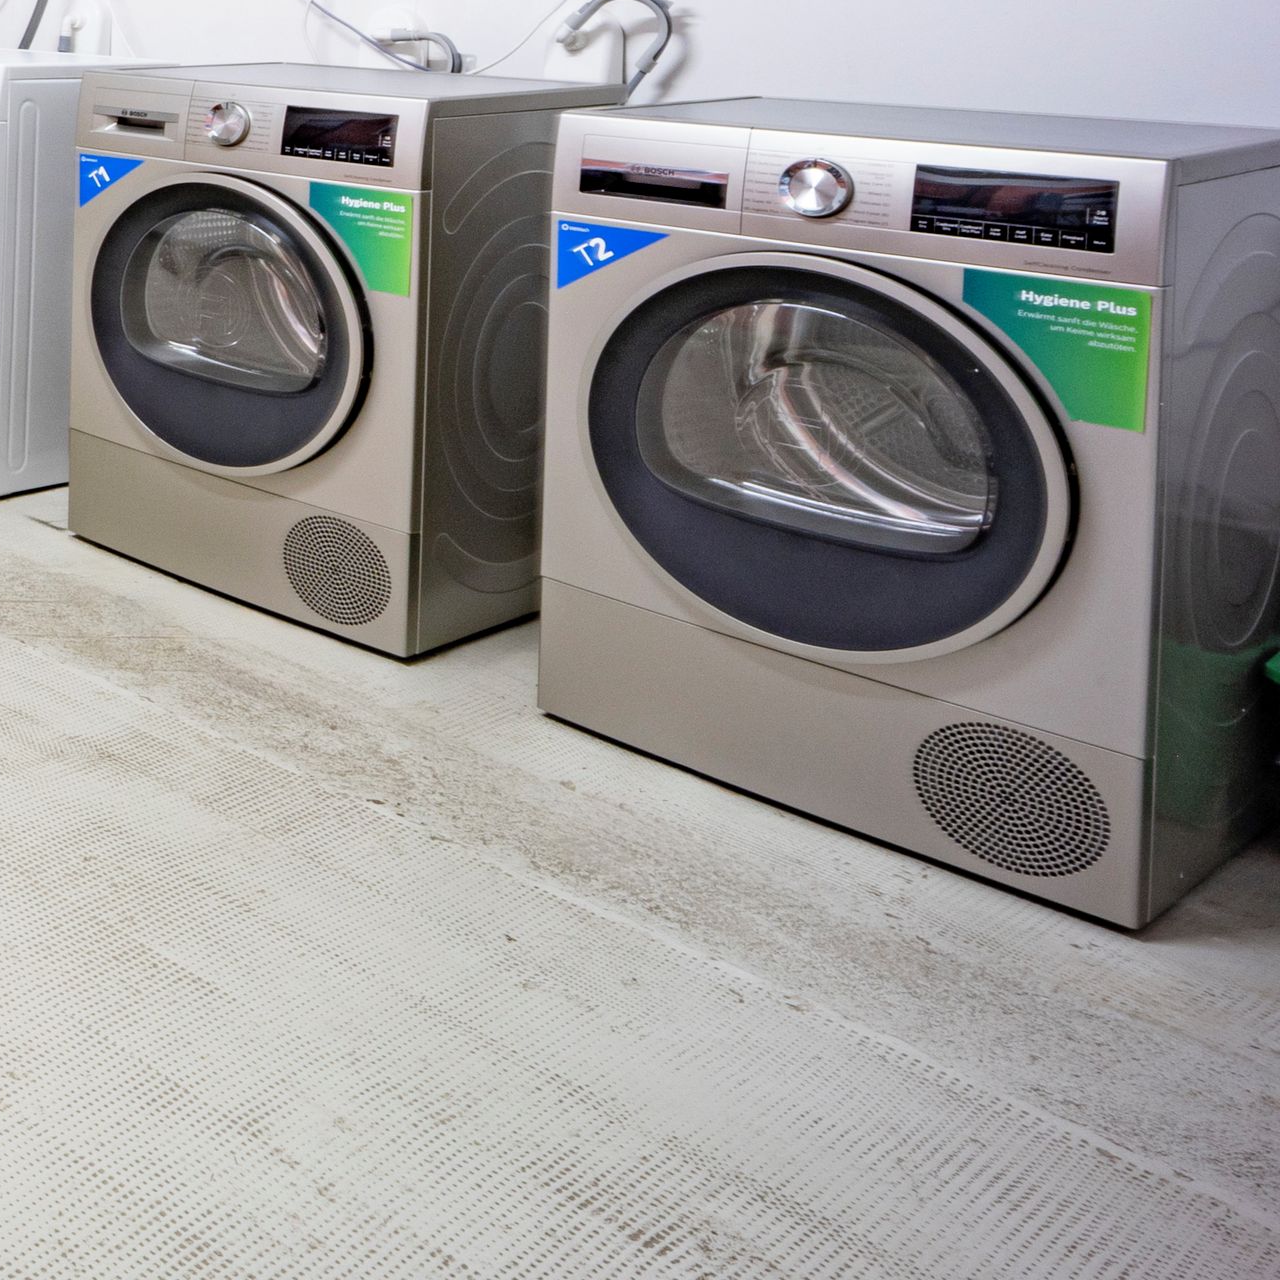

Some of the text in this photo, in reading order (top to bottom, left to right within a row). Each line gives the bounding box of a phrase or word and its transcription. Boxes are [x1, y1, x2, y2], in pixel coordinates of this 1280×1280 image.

[88, 166, 111, 187] T1
[644, 166, 675, 176] BOSCH
[341, 196, 406, 213] Hygiene Plus
[572, 237, 615, 266] T2
[1020, 290, 1138, 317] Hygiene Plus
[1017, 309, 1056, 321] Erwärmt
[1057, 316, 1081, 325] sanft
[1082, 319, 1097, 328] die
[1050, 324, 1137, 342] um Keime wirksam
